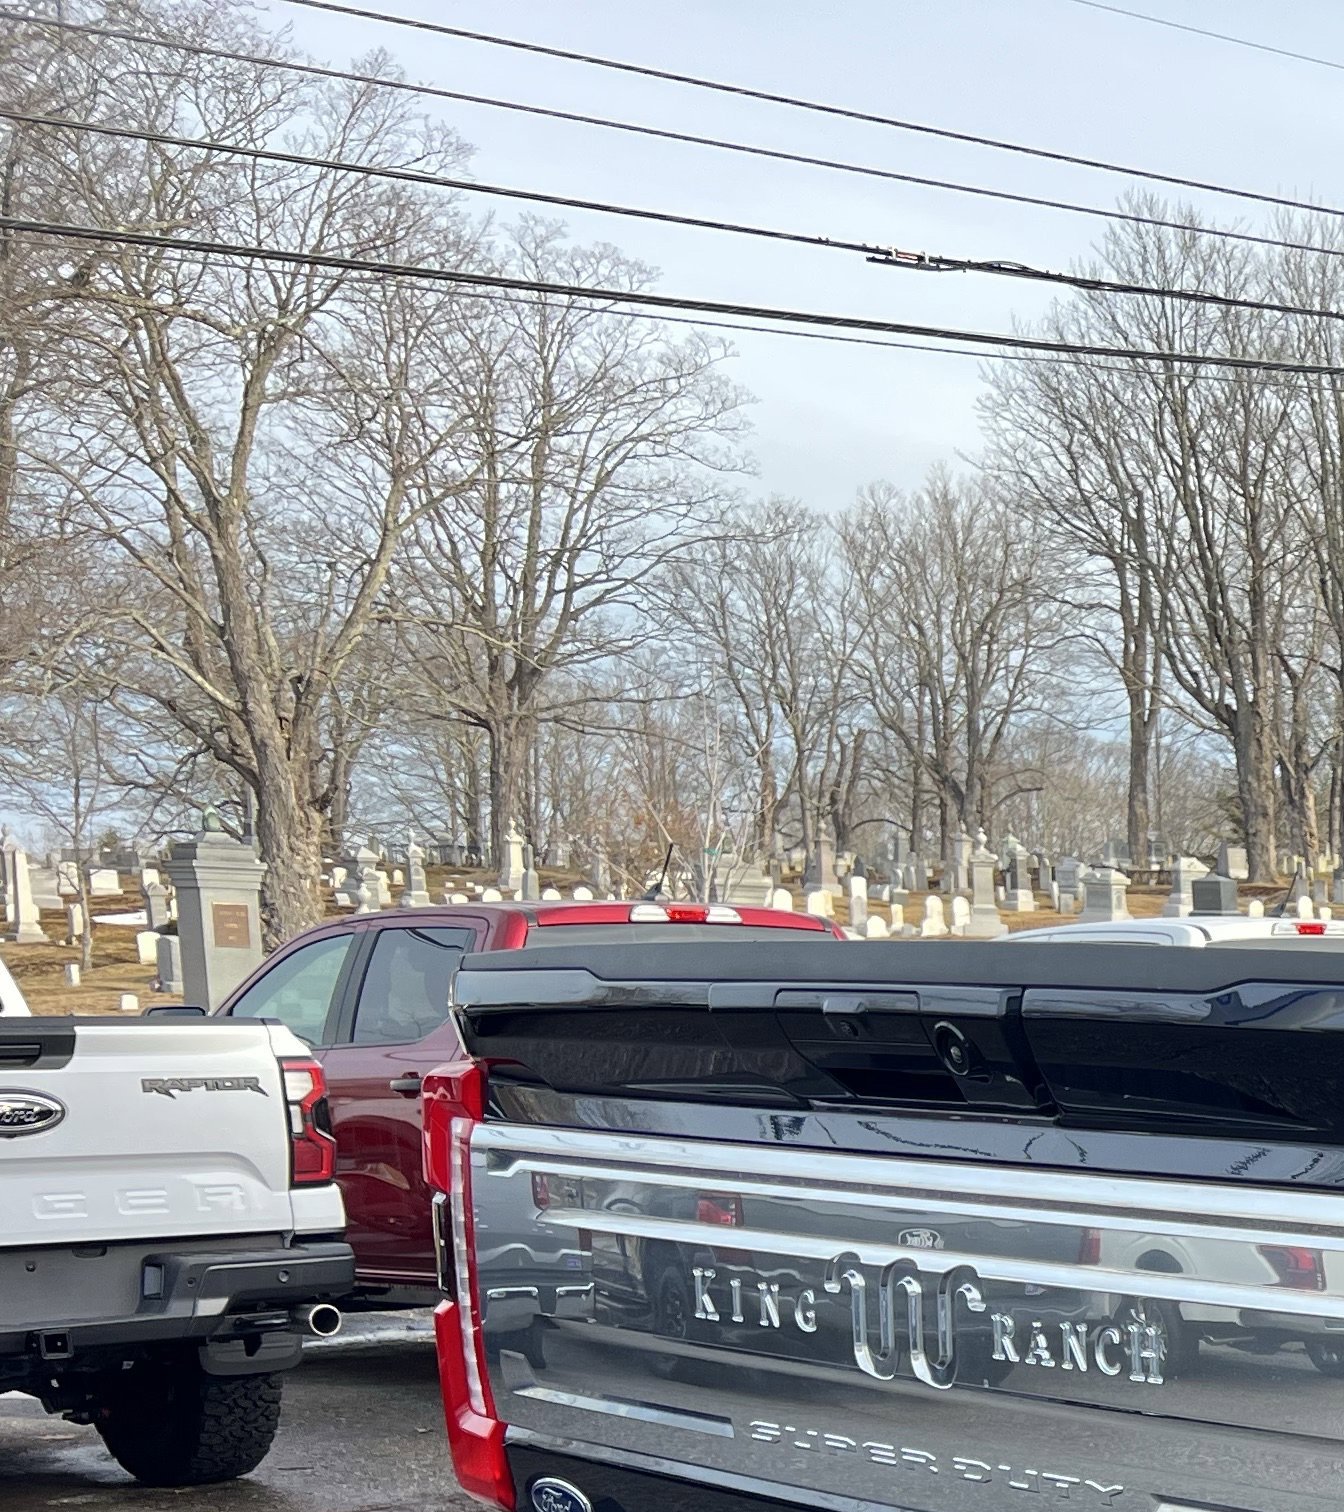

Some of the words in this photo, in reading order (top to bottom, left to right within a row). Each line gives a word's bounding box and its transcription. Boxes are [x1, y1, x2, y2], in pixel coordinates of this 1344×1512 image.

[141, 1076, 269, 1099] RAPTOR
[692, 1266, 818, 1333] KING
[991, 1312, 1165, 1385] RANCH
[749, 1420, 938, 1474] SUPER
[952, 1456, 1124, 1507] DUTY
